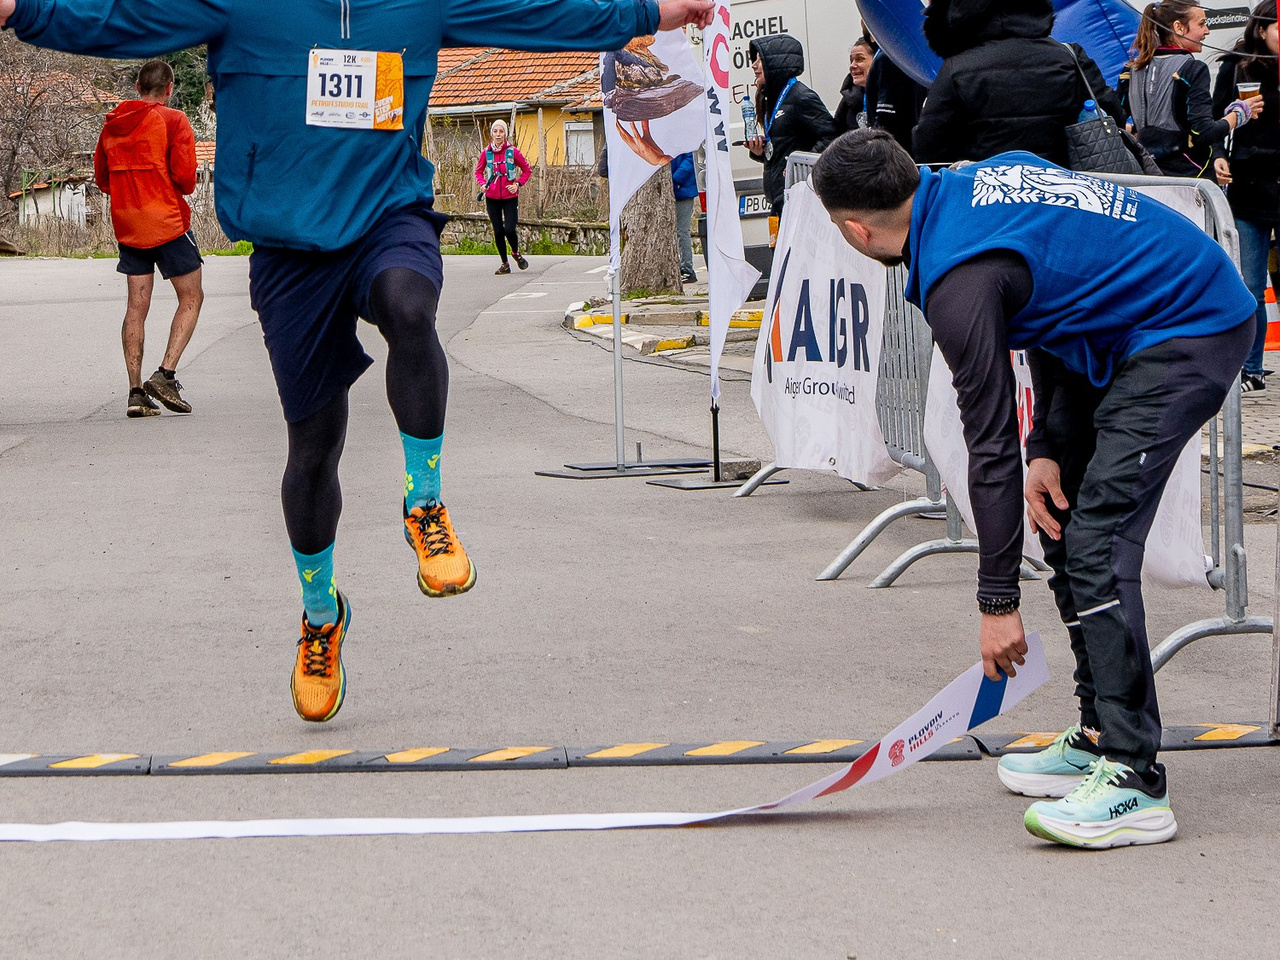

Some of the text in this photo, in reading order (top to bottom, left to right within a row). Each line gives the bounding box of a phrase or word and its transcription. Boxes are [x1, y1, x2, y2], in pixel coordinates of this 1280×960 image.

[730, 16, 788, 41] ACHEL
[343, 55, 357, 63] 12K
[318, 73, 363, 98] 1311
[746, 198, 759, 212] PB
[908, 710, 943, 745] PLOVDIV
[1109, 797, 1139, 820] HOKA
